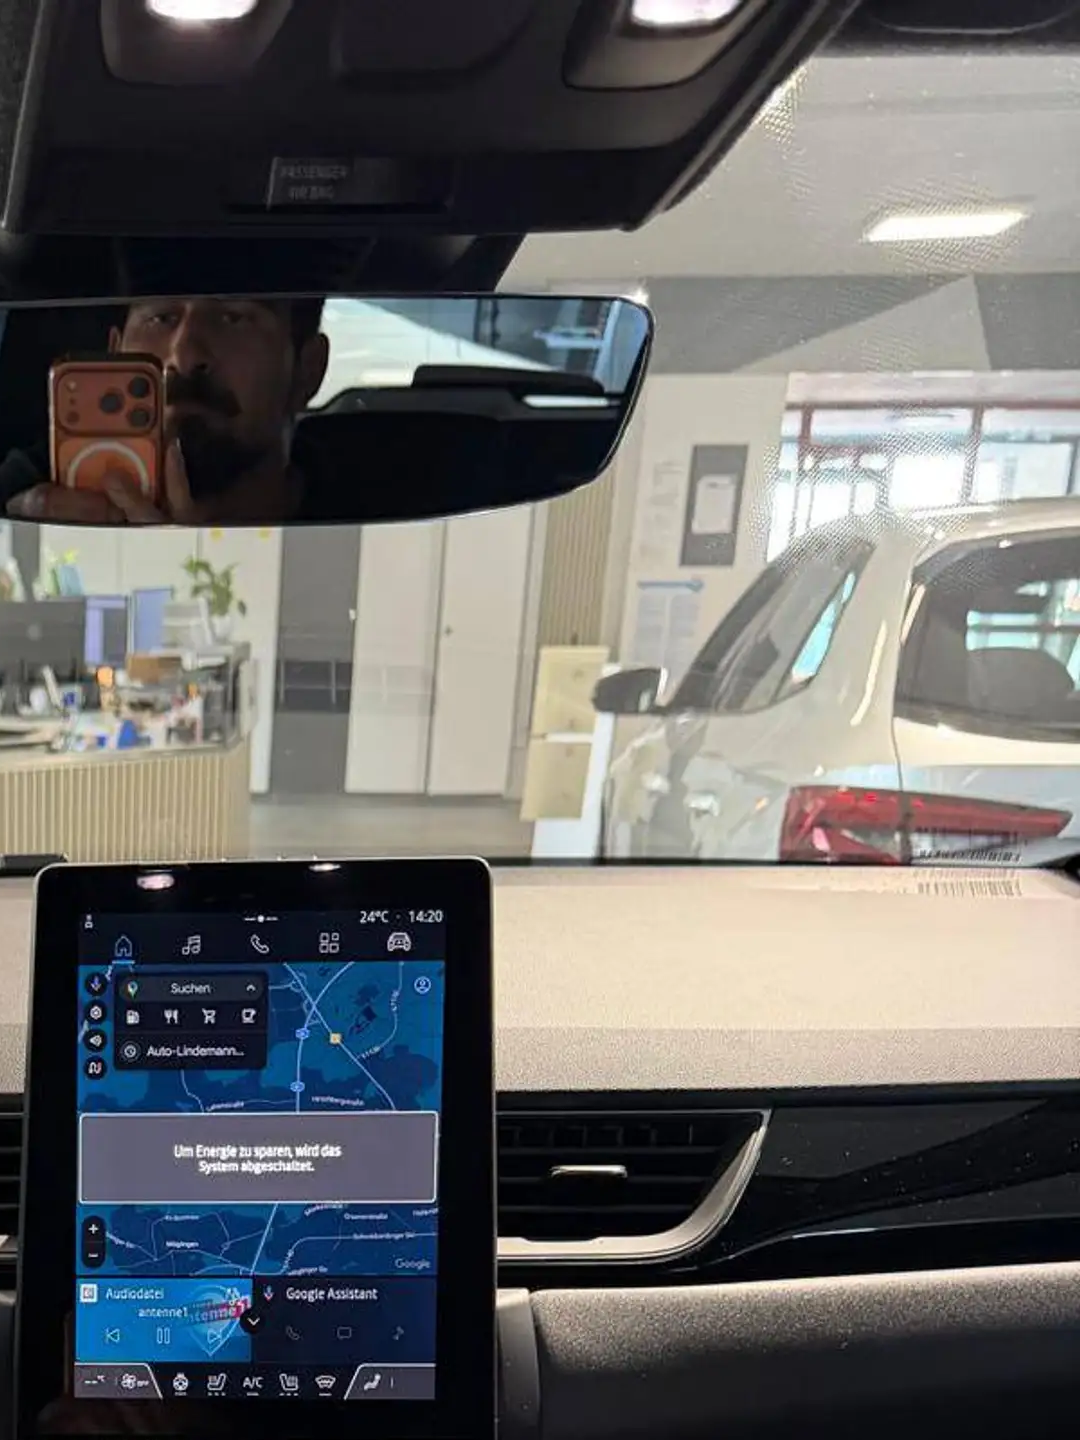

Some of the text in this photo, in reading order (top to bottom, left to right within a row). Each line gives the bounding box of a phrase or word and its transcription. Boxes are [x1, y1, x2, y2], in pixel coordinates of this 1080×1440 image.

[359, 910, 389, 923] 24°C
[408, 910, 443, 923] 14:20
[170, 982, 211, 994] Suchen
[174, 1143, 342, 1160] Um Energie zu sparen, wird das
[198, 1160, 315, 1174] System abgeschaltet.
[395, 1258, 431, 1270] Google
[105, 1287, 164, 1299] Audiodatei
[286, 1287, 378, 1301] Google Assistant
[242, 1377, 263, 1389] A/C
